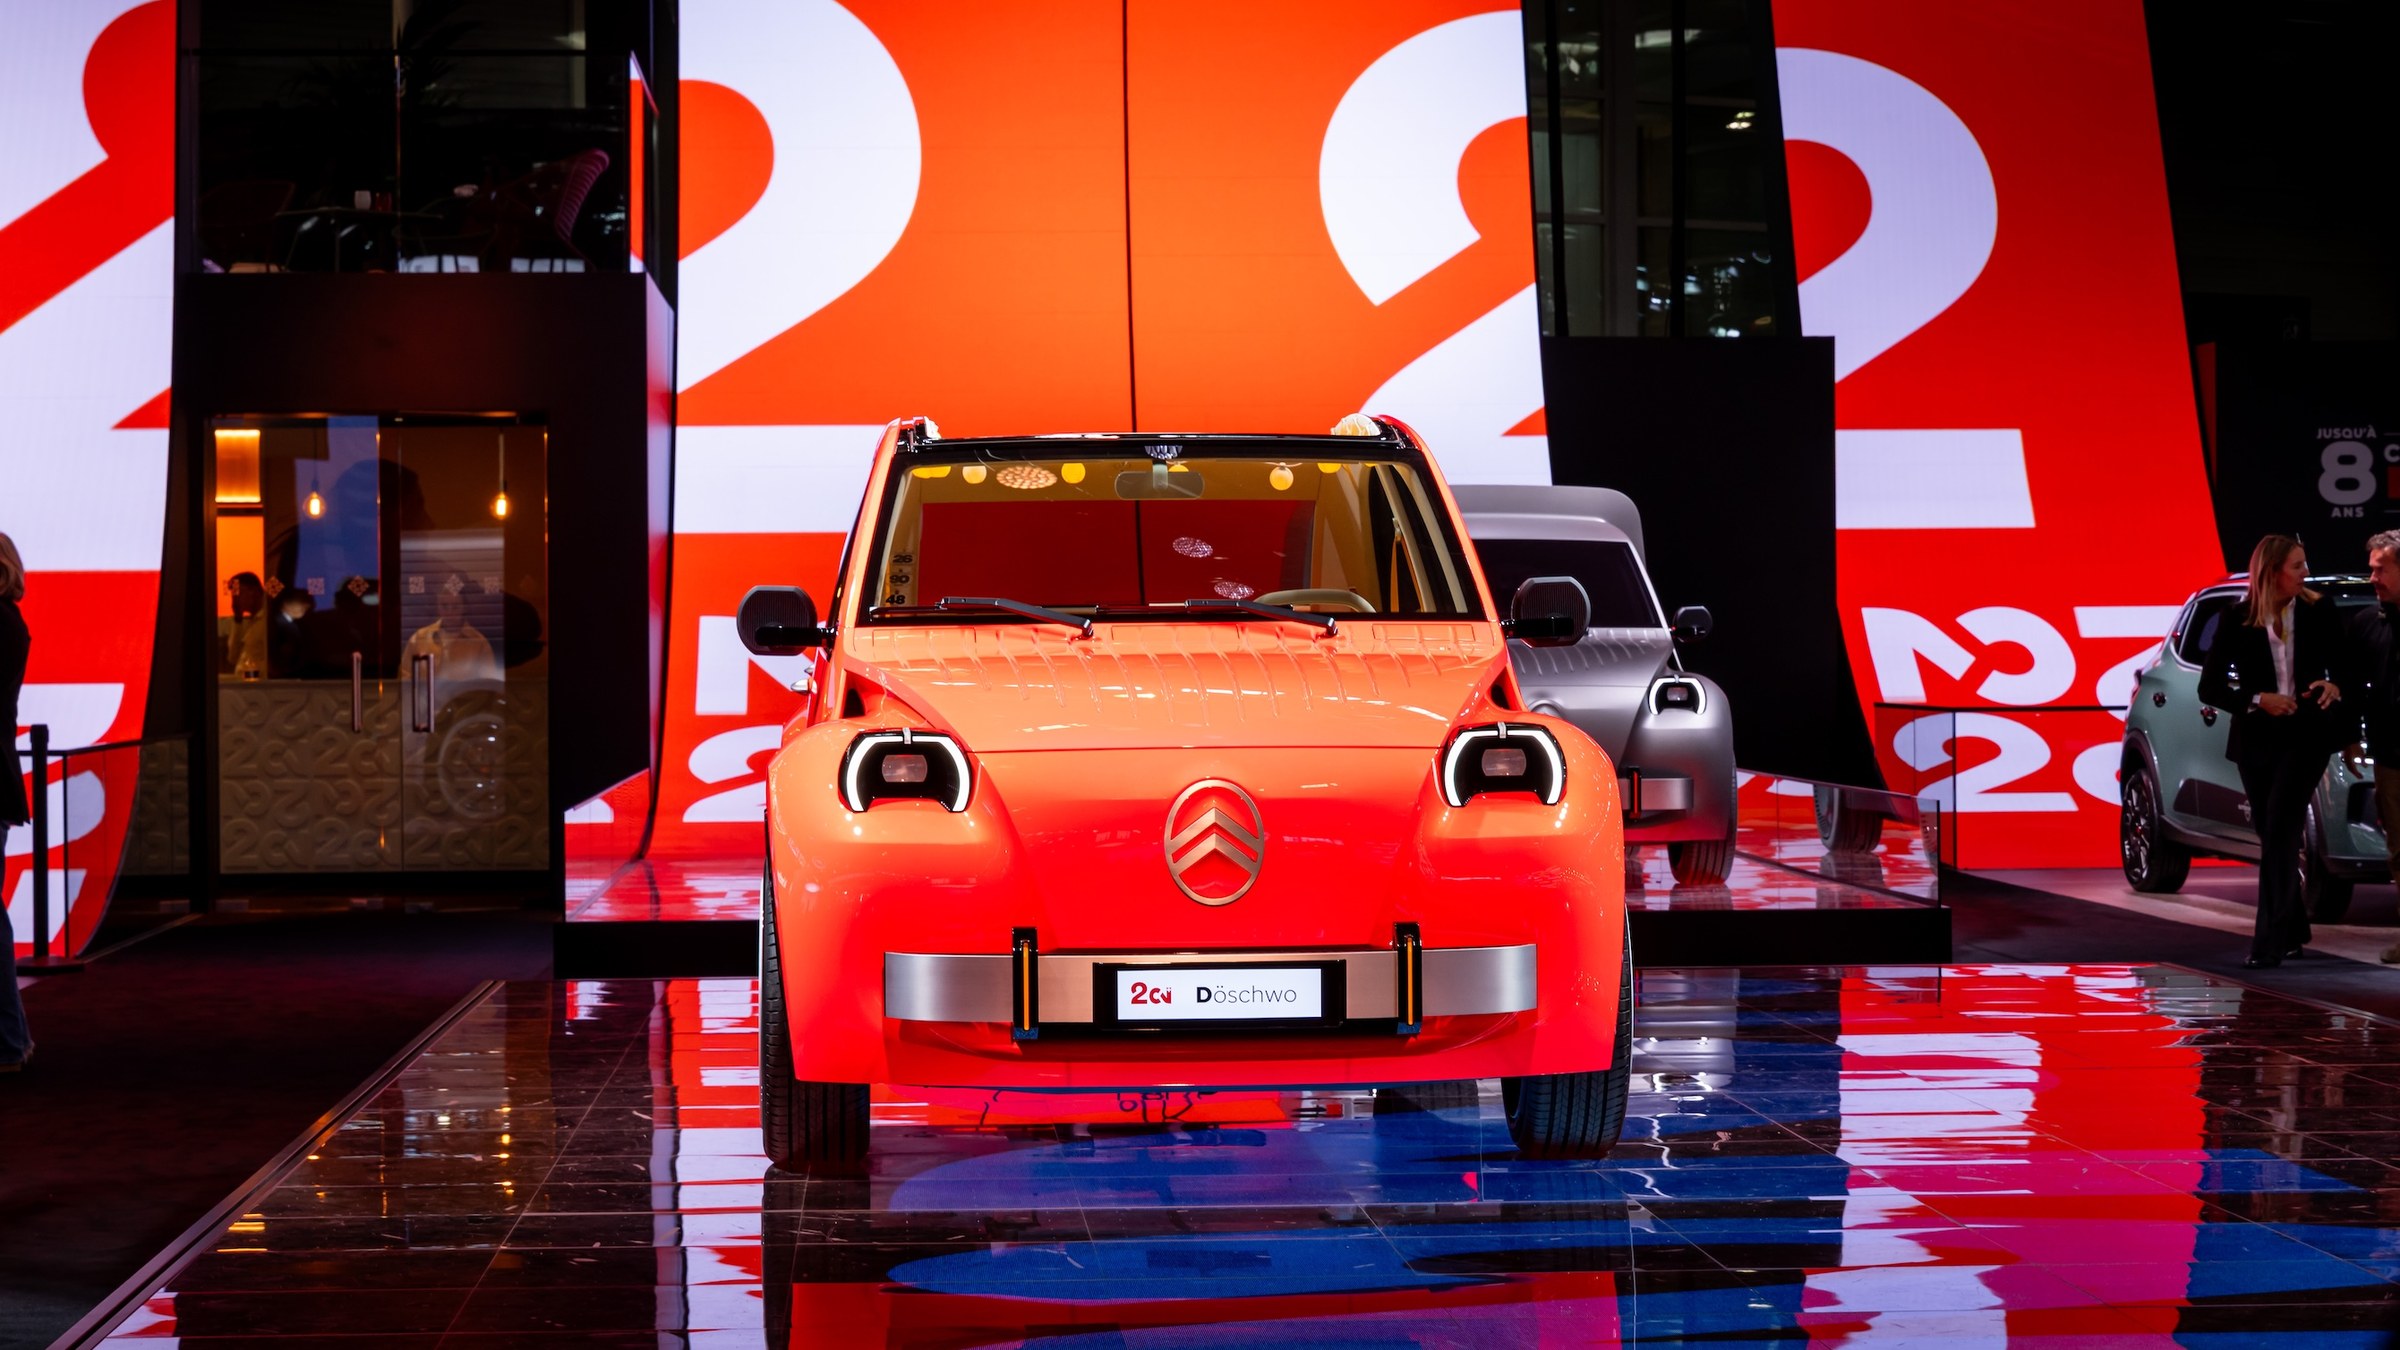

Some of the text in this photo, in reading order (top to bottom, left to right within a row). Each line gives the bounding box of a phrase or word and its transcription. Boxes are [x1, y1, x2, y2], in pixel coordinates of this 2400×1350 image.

[2316, 424, 2377, 439] JUSQU'À
[2318, 440, 2377, 505] 8
[2331, 507, 2364, 518] ANS
[1196, 985, 1297, 1004] Döschwo
